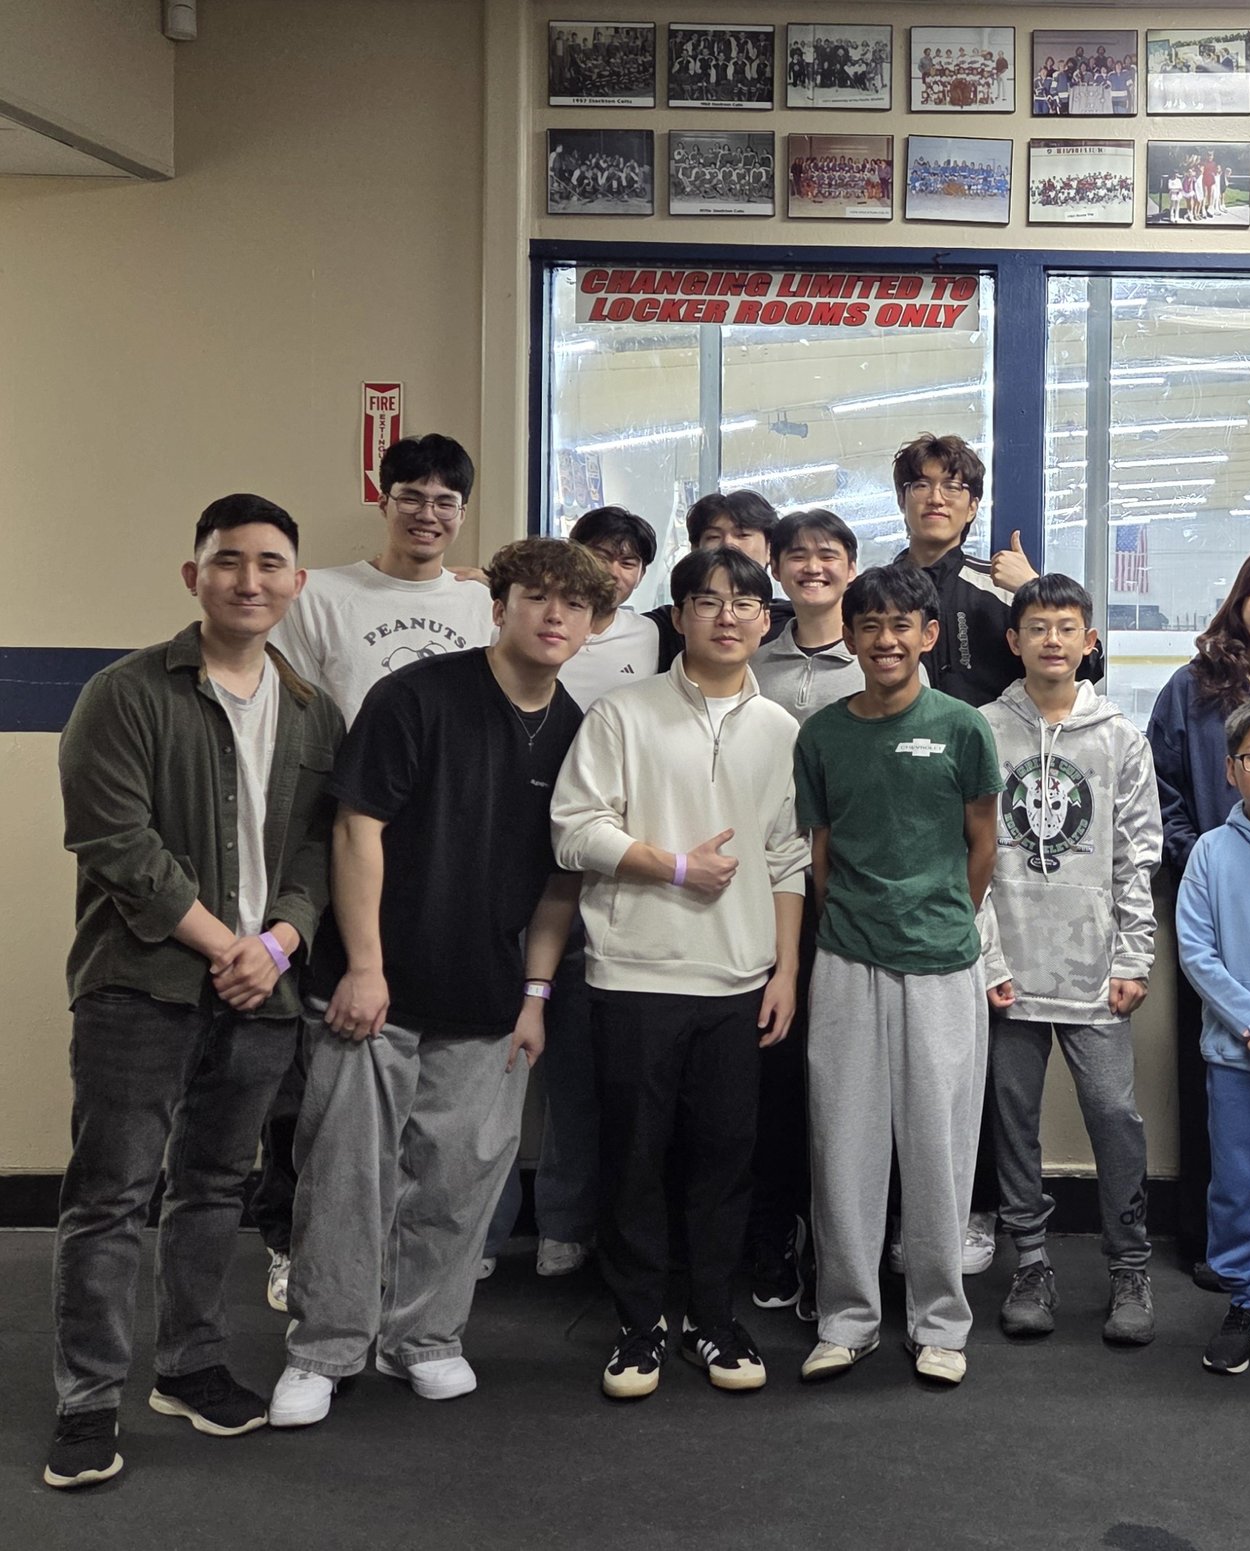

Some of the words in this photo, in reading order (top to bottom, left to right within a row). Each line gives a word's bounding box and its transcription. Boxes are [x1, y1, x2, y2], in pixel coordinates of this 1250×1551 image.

[580, 271, 773, 297] CHANGING
[776, 273, 927, 300] LIMITED
[930, 276, 979, 301] TO
[588, 297, 732, 323] LOCKER
[732, 300, 869, 327] ROOMS
[875, 303, 969, 328] ONLY
[369, 396, 396, 411] FIRE
[363, 617, 467, 649] PEANUTS
